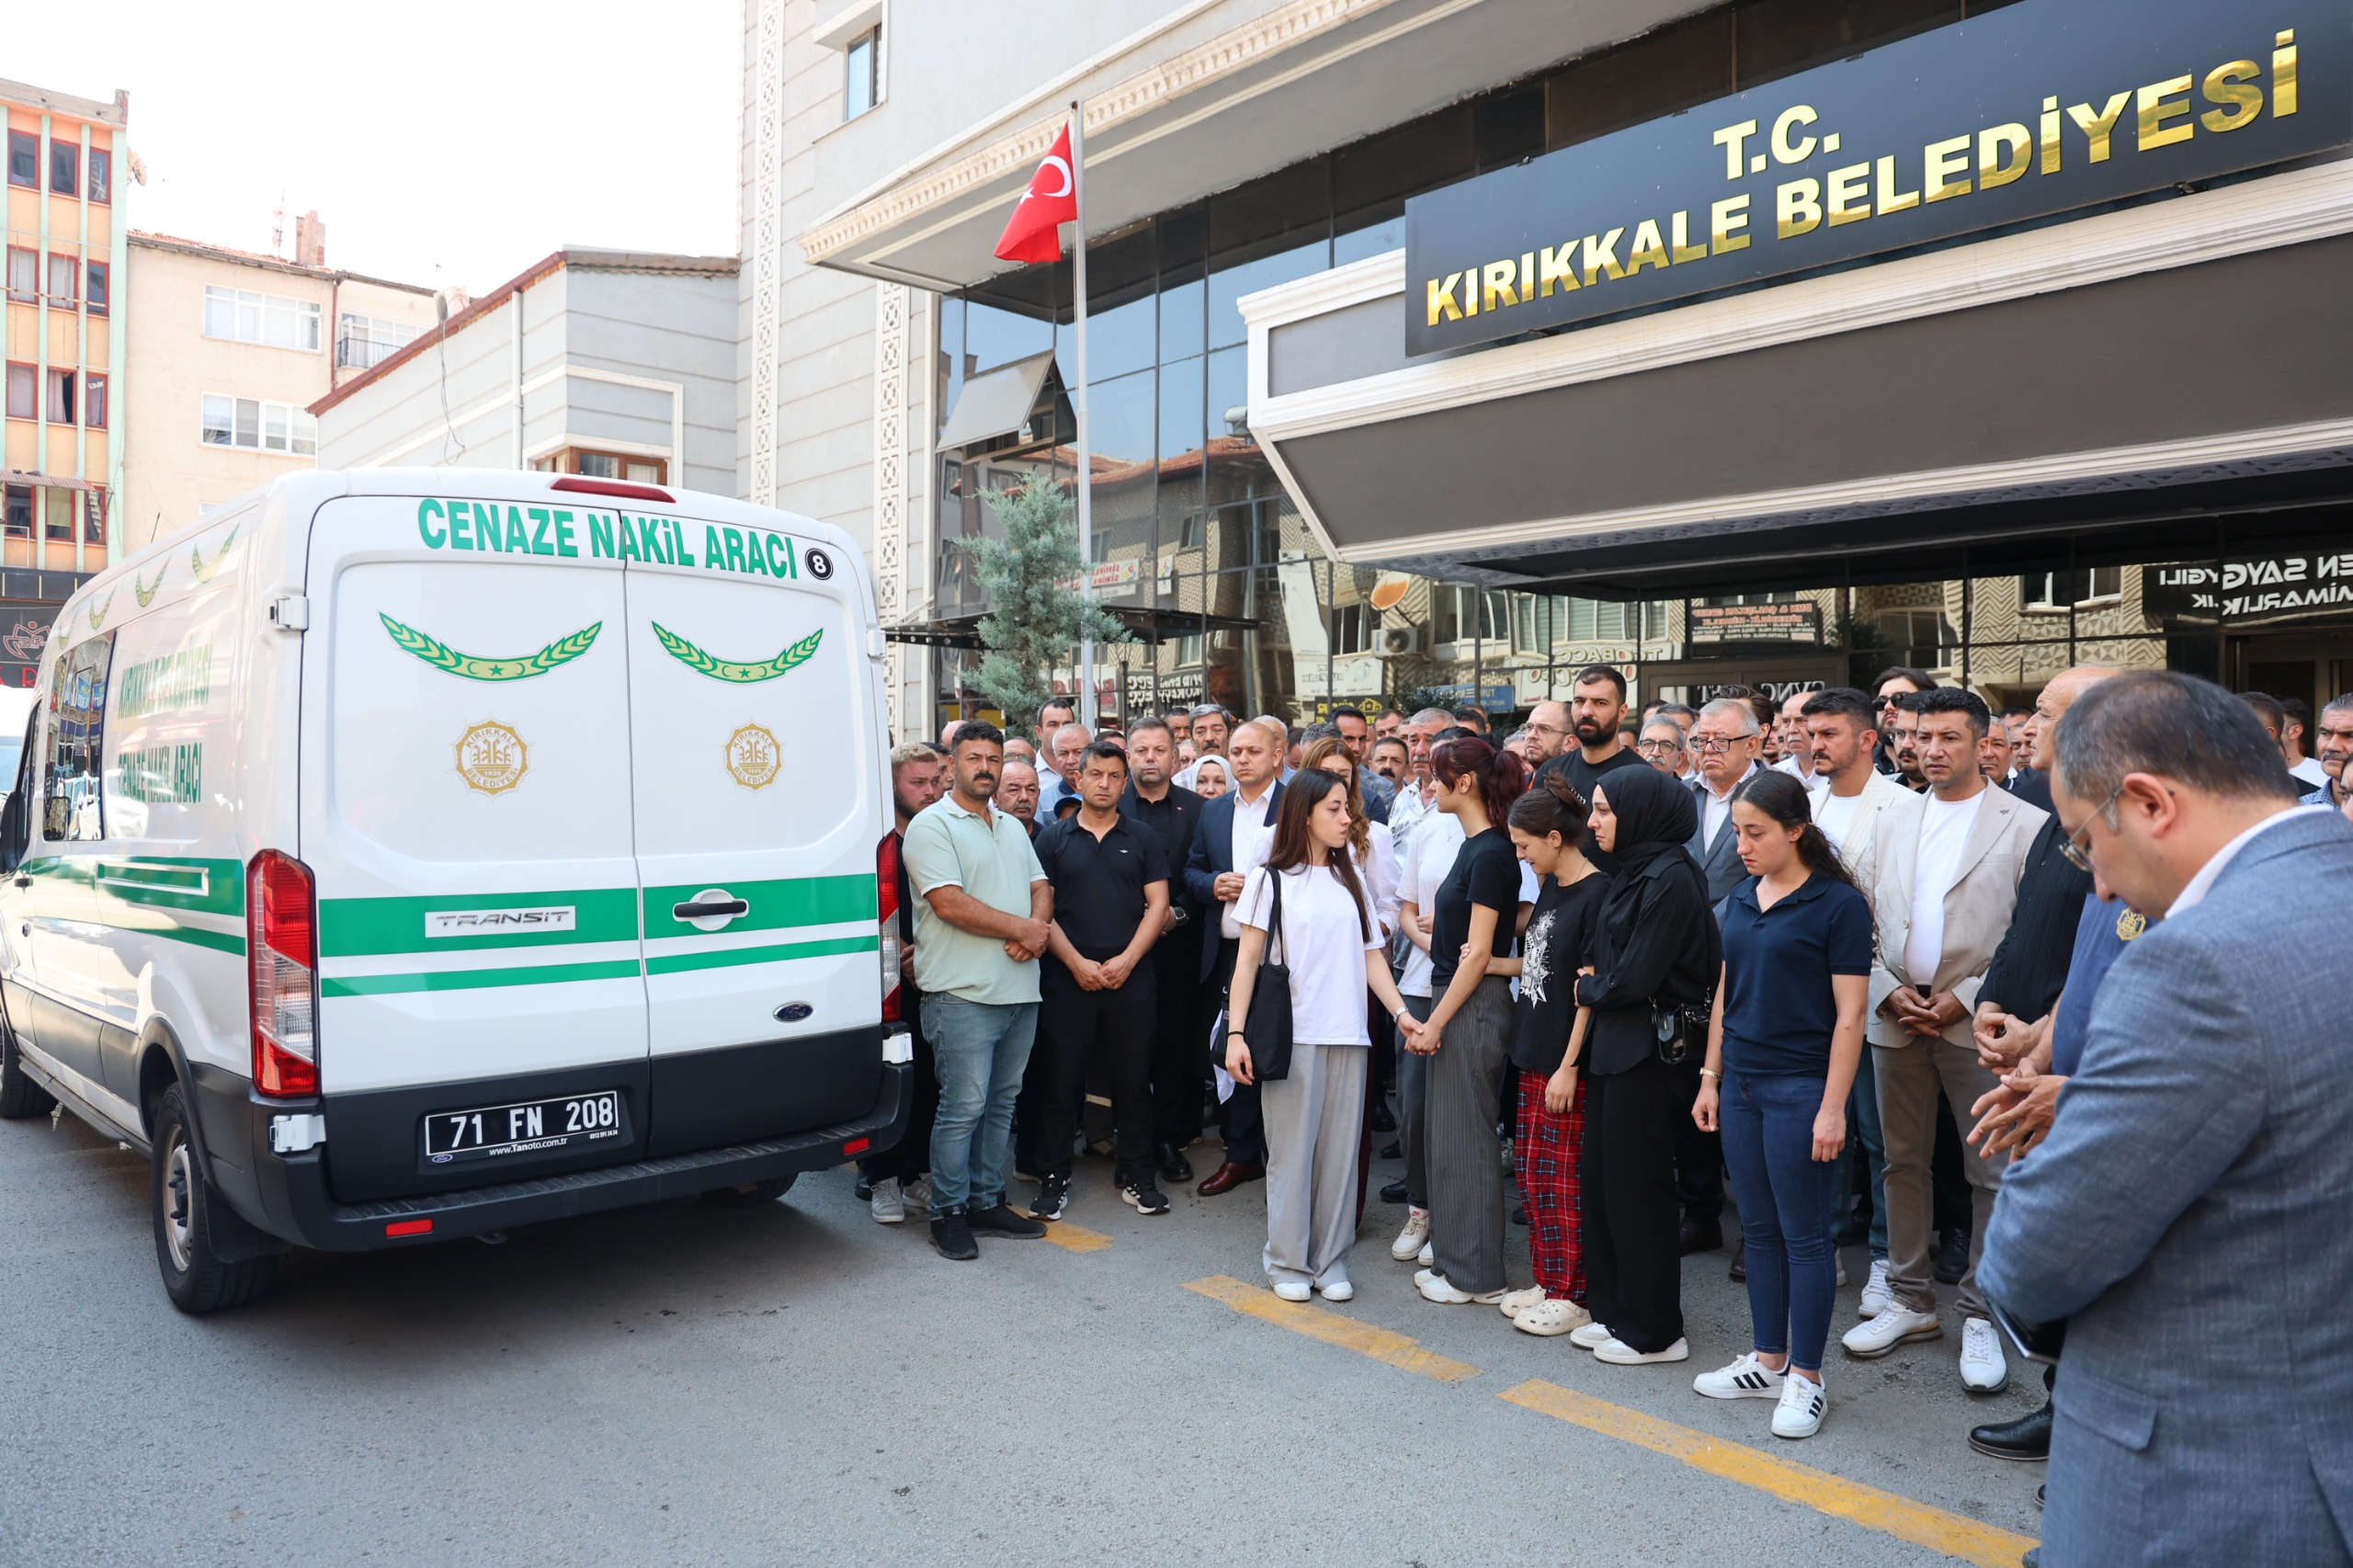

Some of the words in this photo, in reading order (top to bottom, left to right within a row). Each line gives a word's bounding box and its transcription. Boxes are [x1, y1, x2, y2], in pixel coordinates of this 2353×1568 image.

[1713, 104, 1841, 181] T.C.
[1427, 193, 1752, 327] KIRIKKALE
[1776, 28, 2299, 241] BELEDİYESİ
[417, 498, 578, 558] CENAZE
[587, 513, 695, 567] NAKİL
[705, 525, 798, 580] ARACI
[812, 553, 826, 574] 8
[465, 728, 519, 750] KIRIKKALE
[732, 730, 775, 749] KIRIKKALE
[118, 749, 146, 802] CENAZE
[173, 743, 202, 804] ARACI
[466, 767, 518, 788] BELEDİYESİ
[733, 765, 776, 784] BELEDİYESİ
[436, 911, 570, 927] TRANSIT
[450, 1113, 483, 1149] 71
[509, 1106, 543, 1141] FN
[565, 1096, 614, 1132] 208
[489, 1136, 568, 1157] www.Tanoto.com.tr
